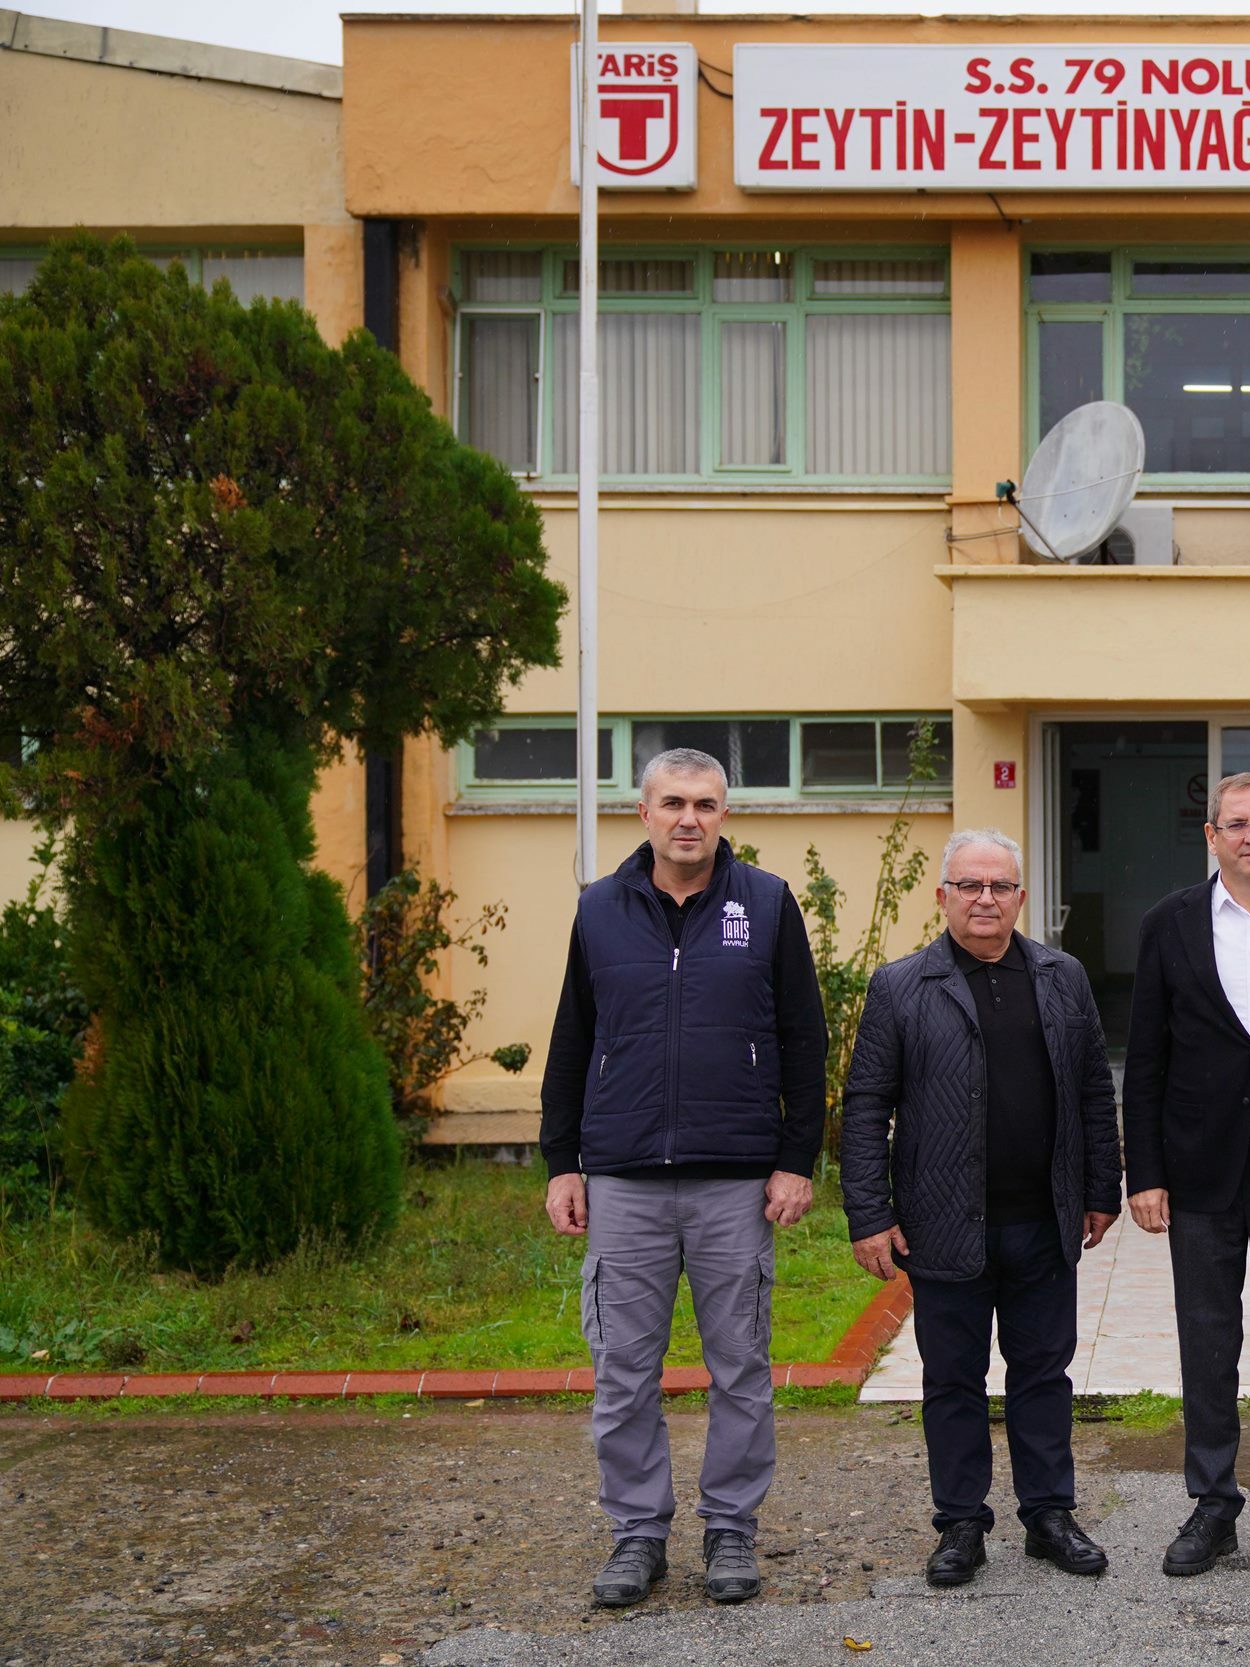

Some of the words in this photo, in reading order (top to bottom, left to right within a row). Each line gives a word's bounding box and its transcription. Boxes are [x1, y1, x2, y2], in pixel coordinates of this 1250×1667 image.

[965, 57, 1049, 95] S.S.
[1065, 58, 1126, 94] 79
[600, 99, 664, 160] T
[1001, 767, 1008, 780] 2
